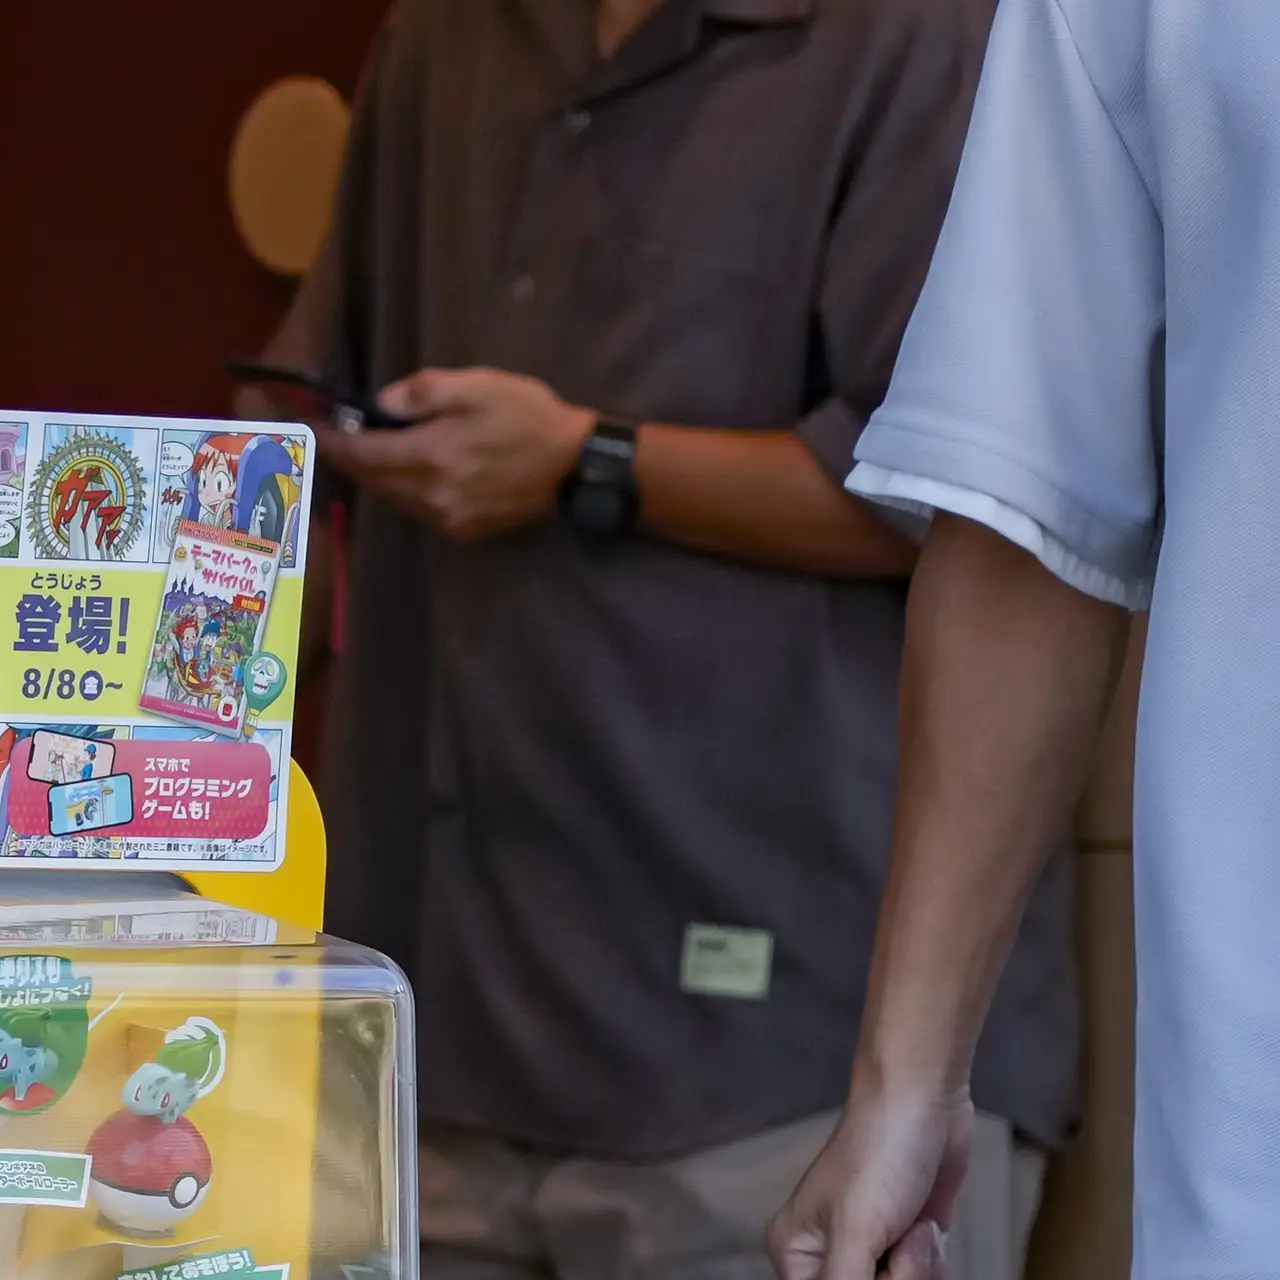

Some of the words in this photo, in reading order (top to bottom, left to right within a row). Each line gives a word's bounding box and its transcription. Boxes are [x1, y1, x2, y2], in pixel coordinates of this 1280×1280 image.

[30, 572, 103, 590] とうじょう
[13, 594, 131, 655] 登場!
[144, 757, 191, 773] スマホで
[143, 777, 253, 798] プログラミング
[141, 799, 210, 821] ゲームも!
